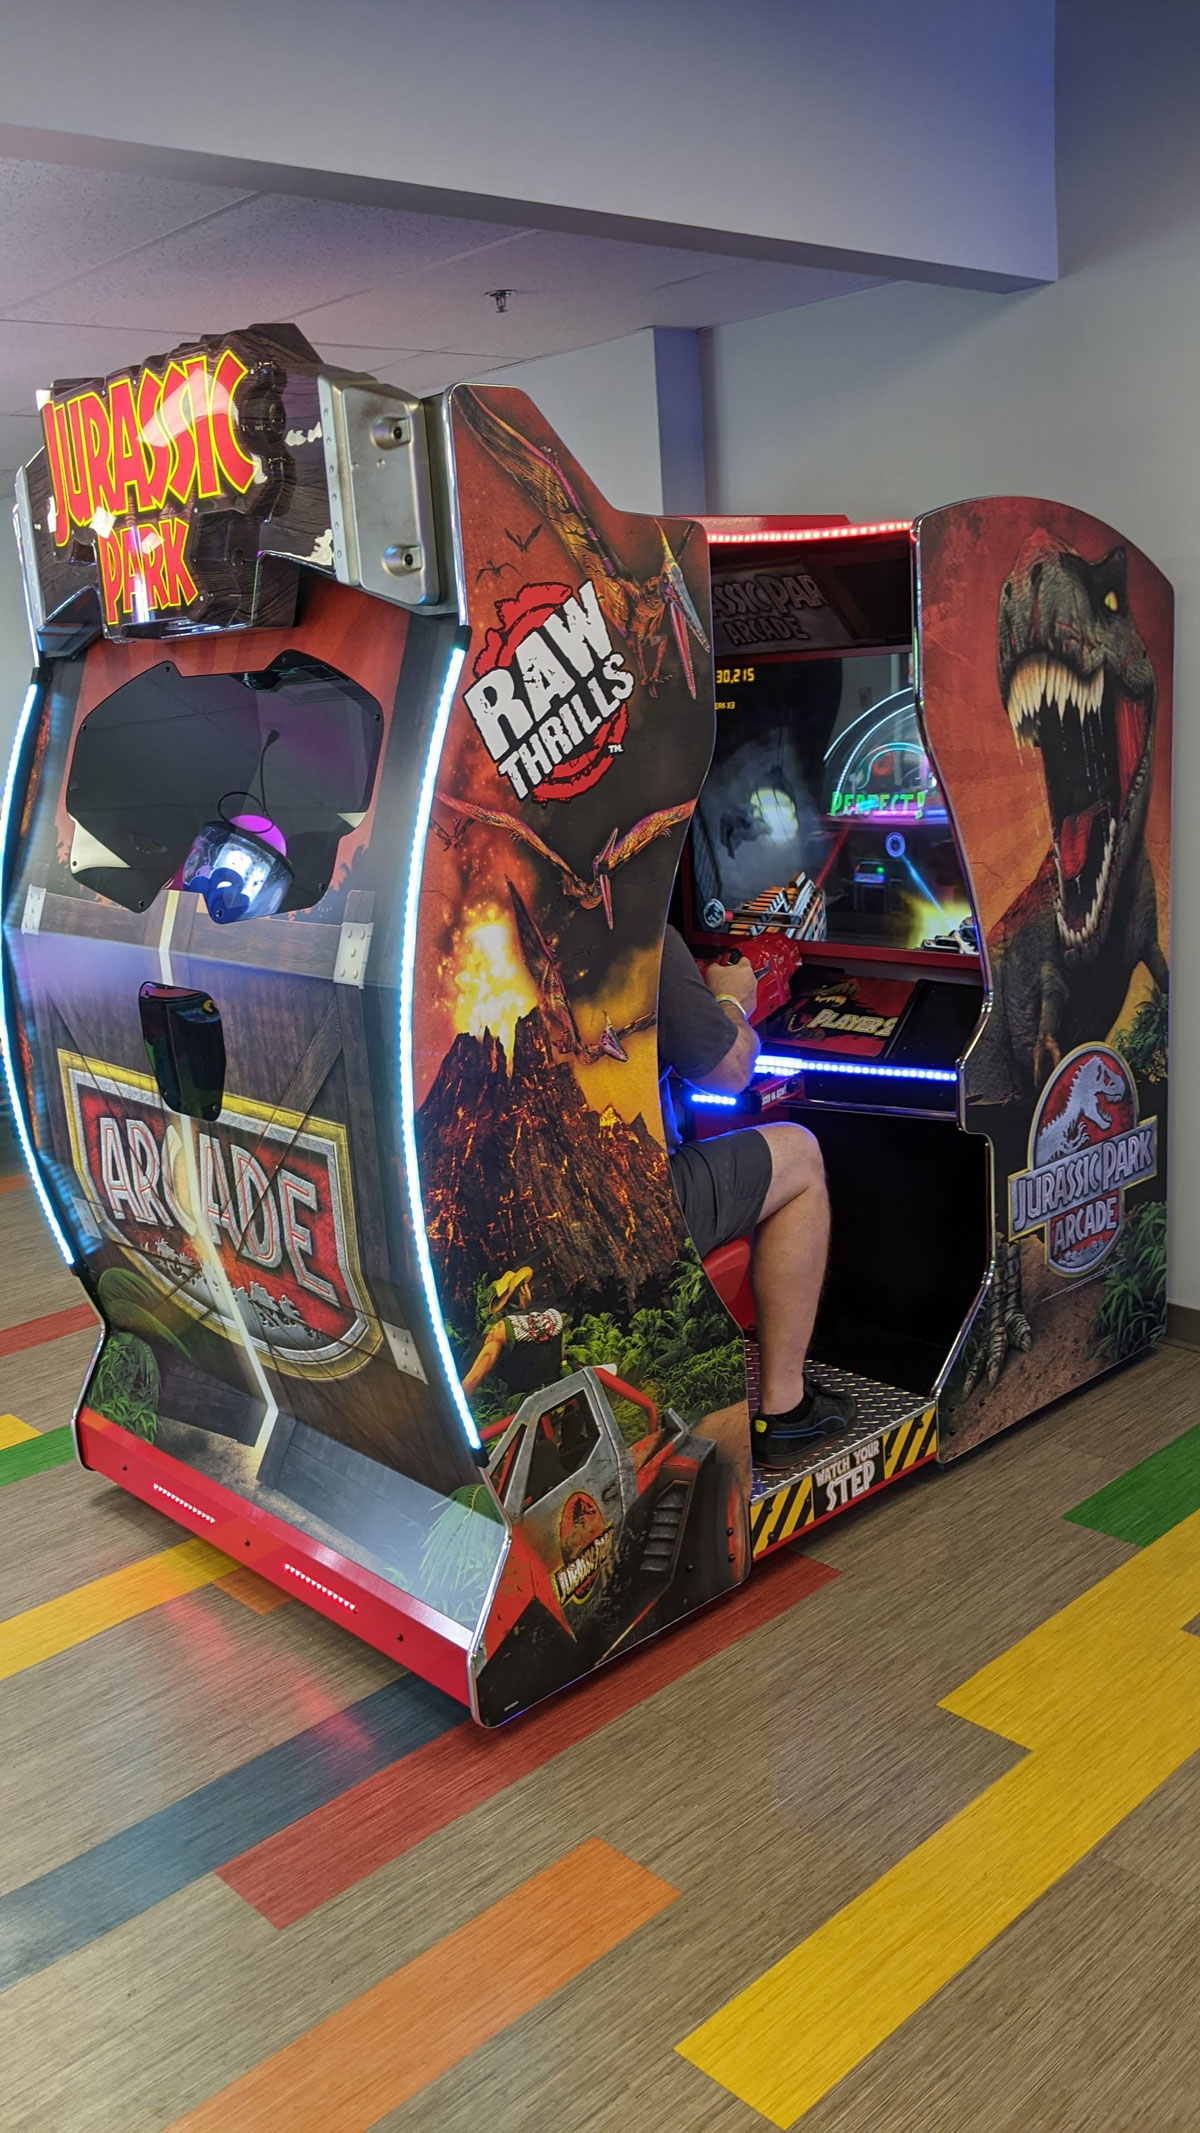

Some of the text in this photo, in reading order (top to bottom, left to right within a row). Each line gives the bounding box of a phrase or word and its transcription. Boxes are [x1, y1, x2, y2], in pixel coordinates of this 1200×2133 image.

[42, 349, 258, 547] JURASSIC
[98, 517, 198, 625] PARK
[463, 580, 613, 761] RAW
[724, 615, 810, 645] ARCADE
[497, 653, 635, 799] THRILLS
[99, 1117, 341, 1308] ARCADE
[1014, 1130, 1153, 1230] JURASSIC PARK
[1053, 1197, 1118, 1252] ARCADE
[814, 1440, 880, 1487] WATCH YOUR
[826, 1460, 875, 1511] STEP
